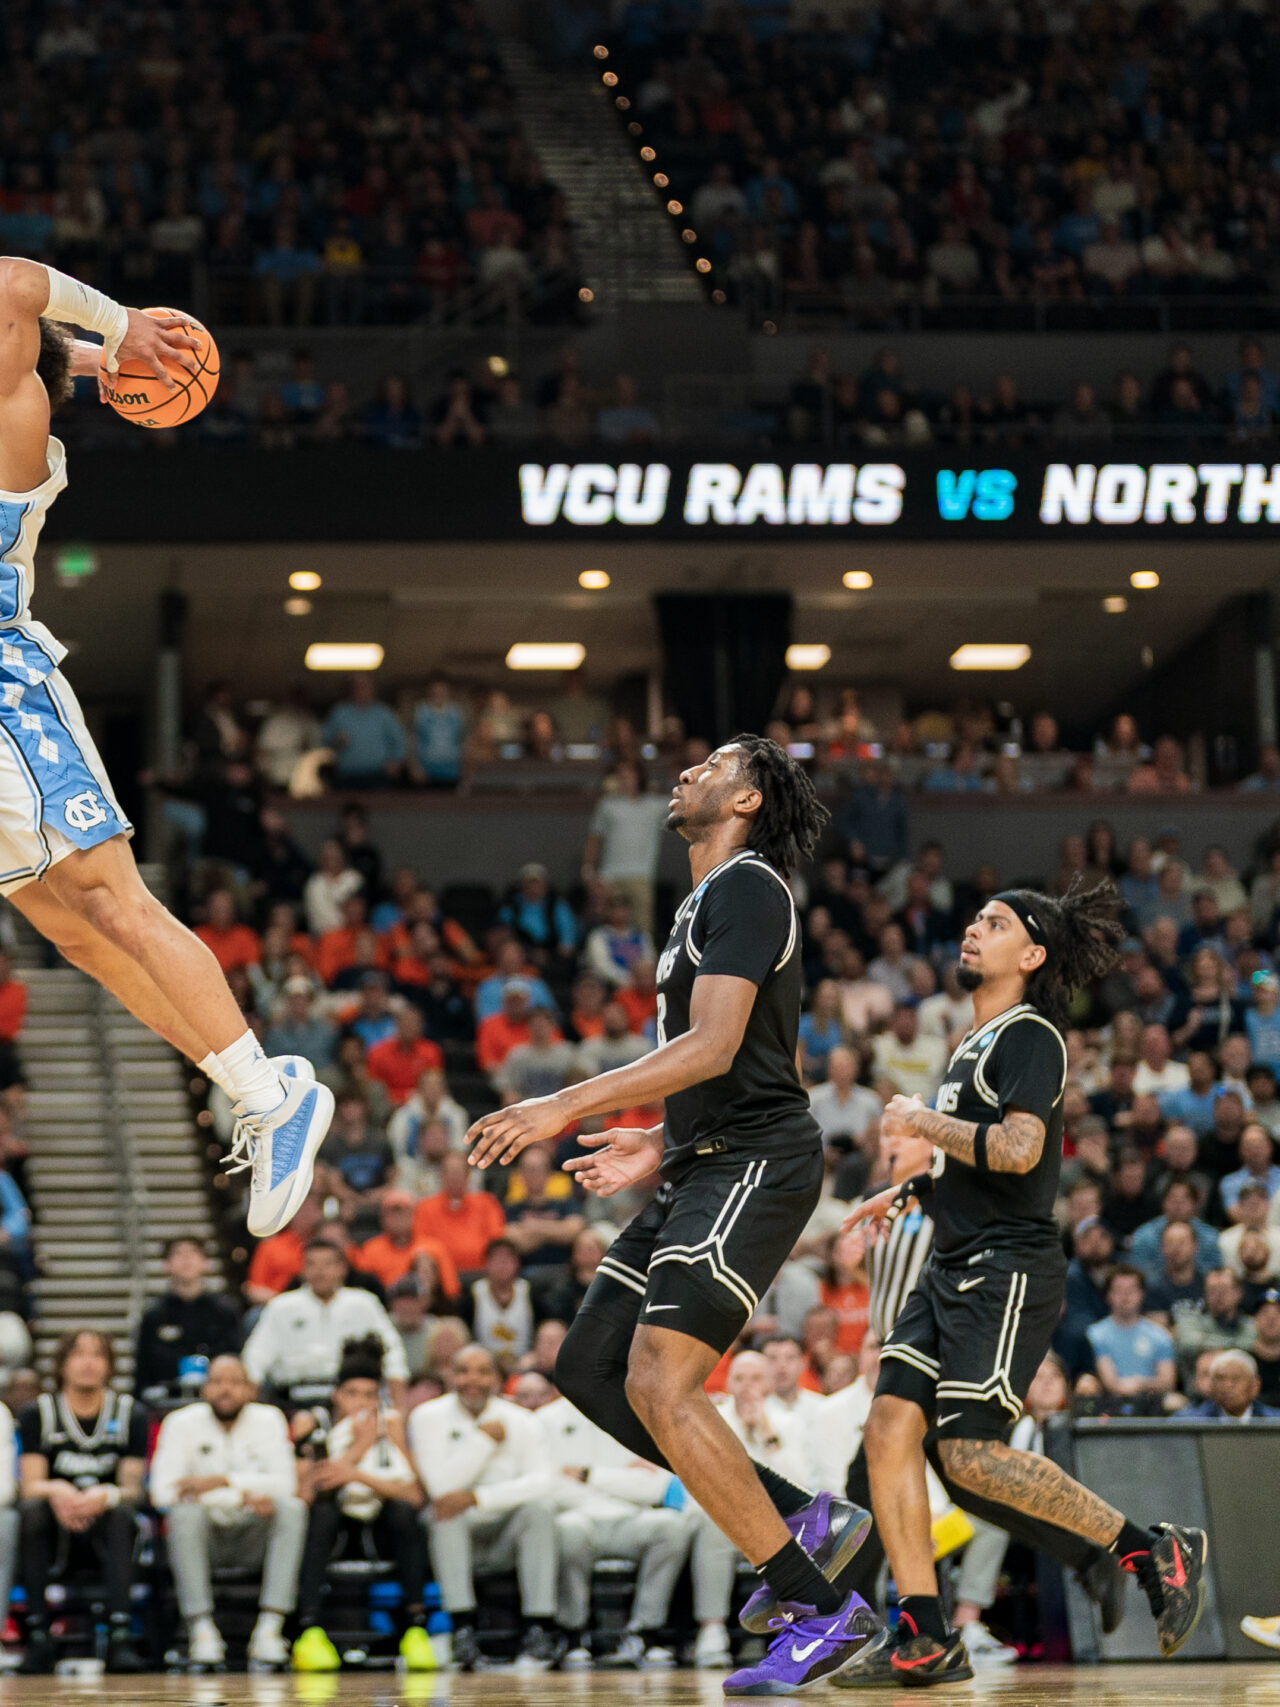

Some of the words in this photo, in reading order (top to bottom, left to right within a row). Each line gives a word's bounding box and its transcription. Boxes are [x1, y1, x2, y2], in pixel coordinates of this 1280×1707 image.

[519, 463, 671, 525] VCU
[683, 463, 906, 525] RAMS
[936, 469, 1018, 521] VS
[1039, 463, 1280, 525] NORTH
